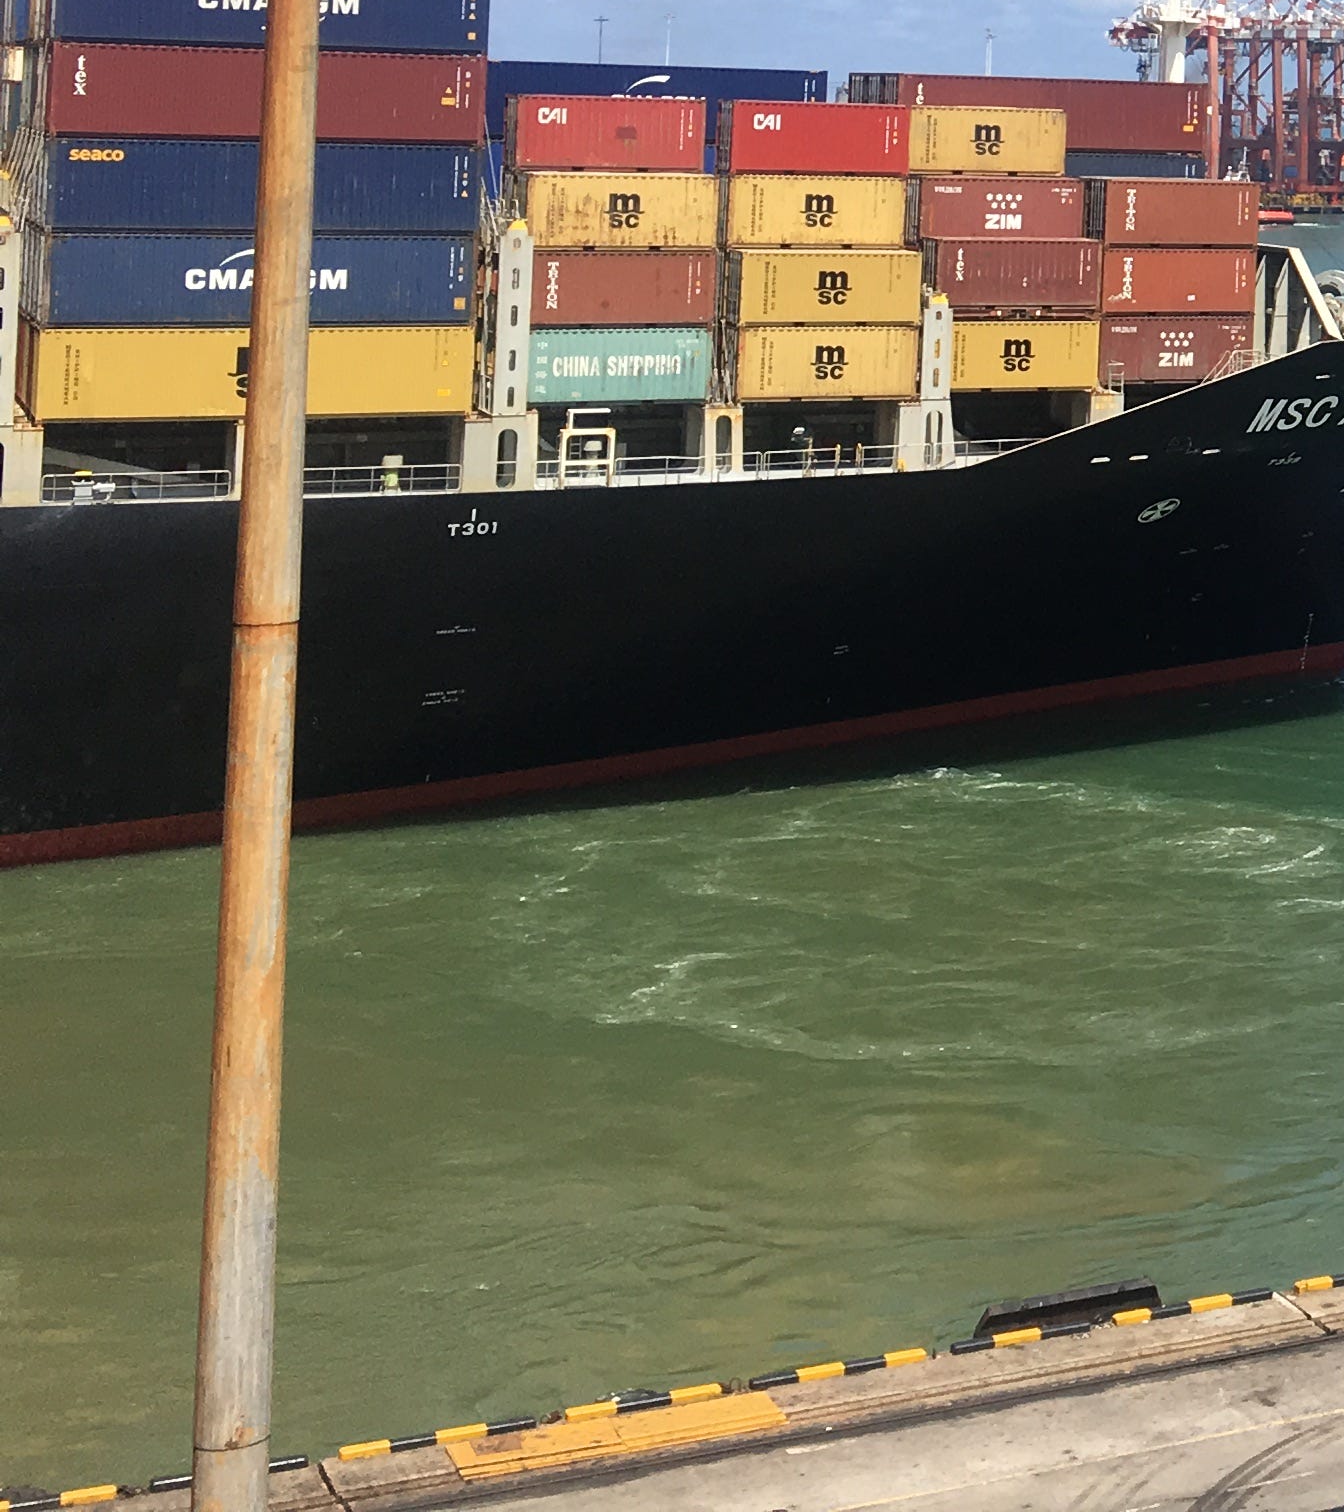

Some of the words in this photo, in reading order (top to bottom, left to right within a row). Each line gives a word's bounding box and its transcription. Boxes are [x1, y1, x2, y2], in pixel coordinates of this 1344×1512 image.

[73, 55, 86, 96] tex
[538, 107, 567, 125] CAI
[753, 113, 782, 131] CAI
[69, 149, 125, 161] seaco
[985, 214, 1022, 230] ZIM
[546, 261, 559, 310] TRITON
[552, 356, 600, 378] CHINA
[1158, 352, 1194, 368] ZIM
[1245, 394, 1339, 434] MSC
[447, 521, 498, 537] T301
